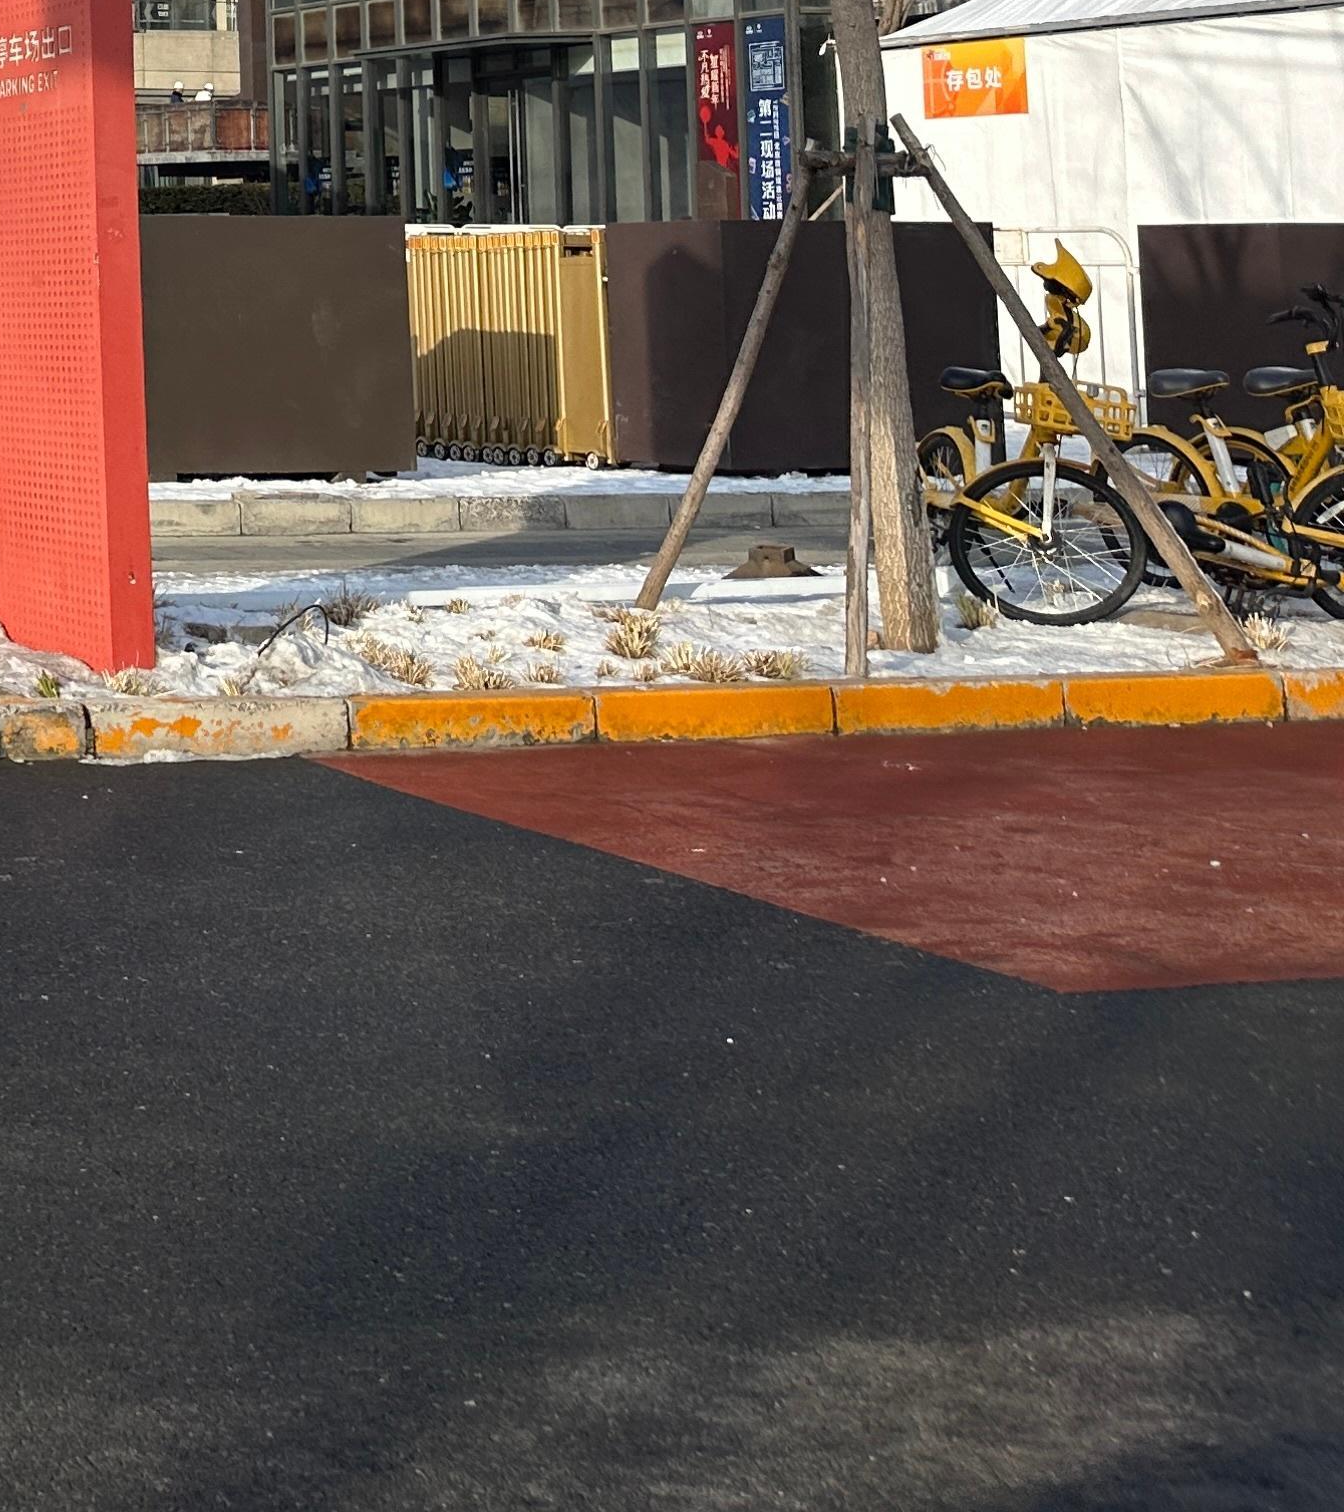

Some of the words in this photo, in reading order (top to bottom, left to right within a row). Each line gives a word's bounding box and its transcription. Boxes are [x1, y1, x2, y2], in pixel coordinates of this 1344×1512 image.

[37, 70, 59, 92] EXIT
[946, 65, 1002, 92] 存包处
[758, 98, 777, 220] 第二现场活动
